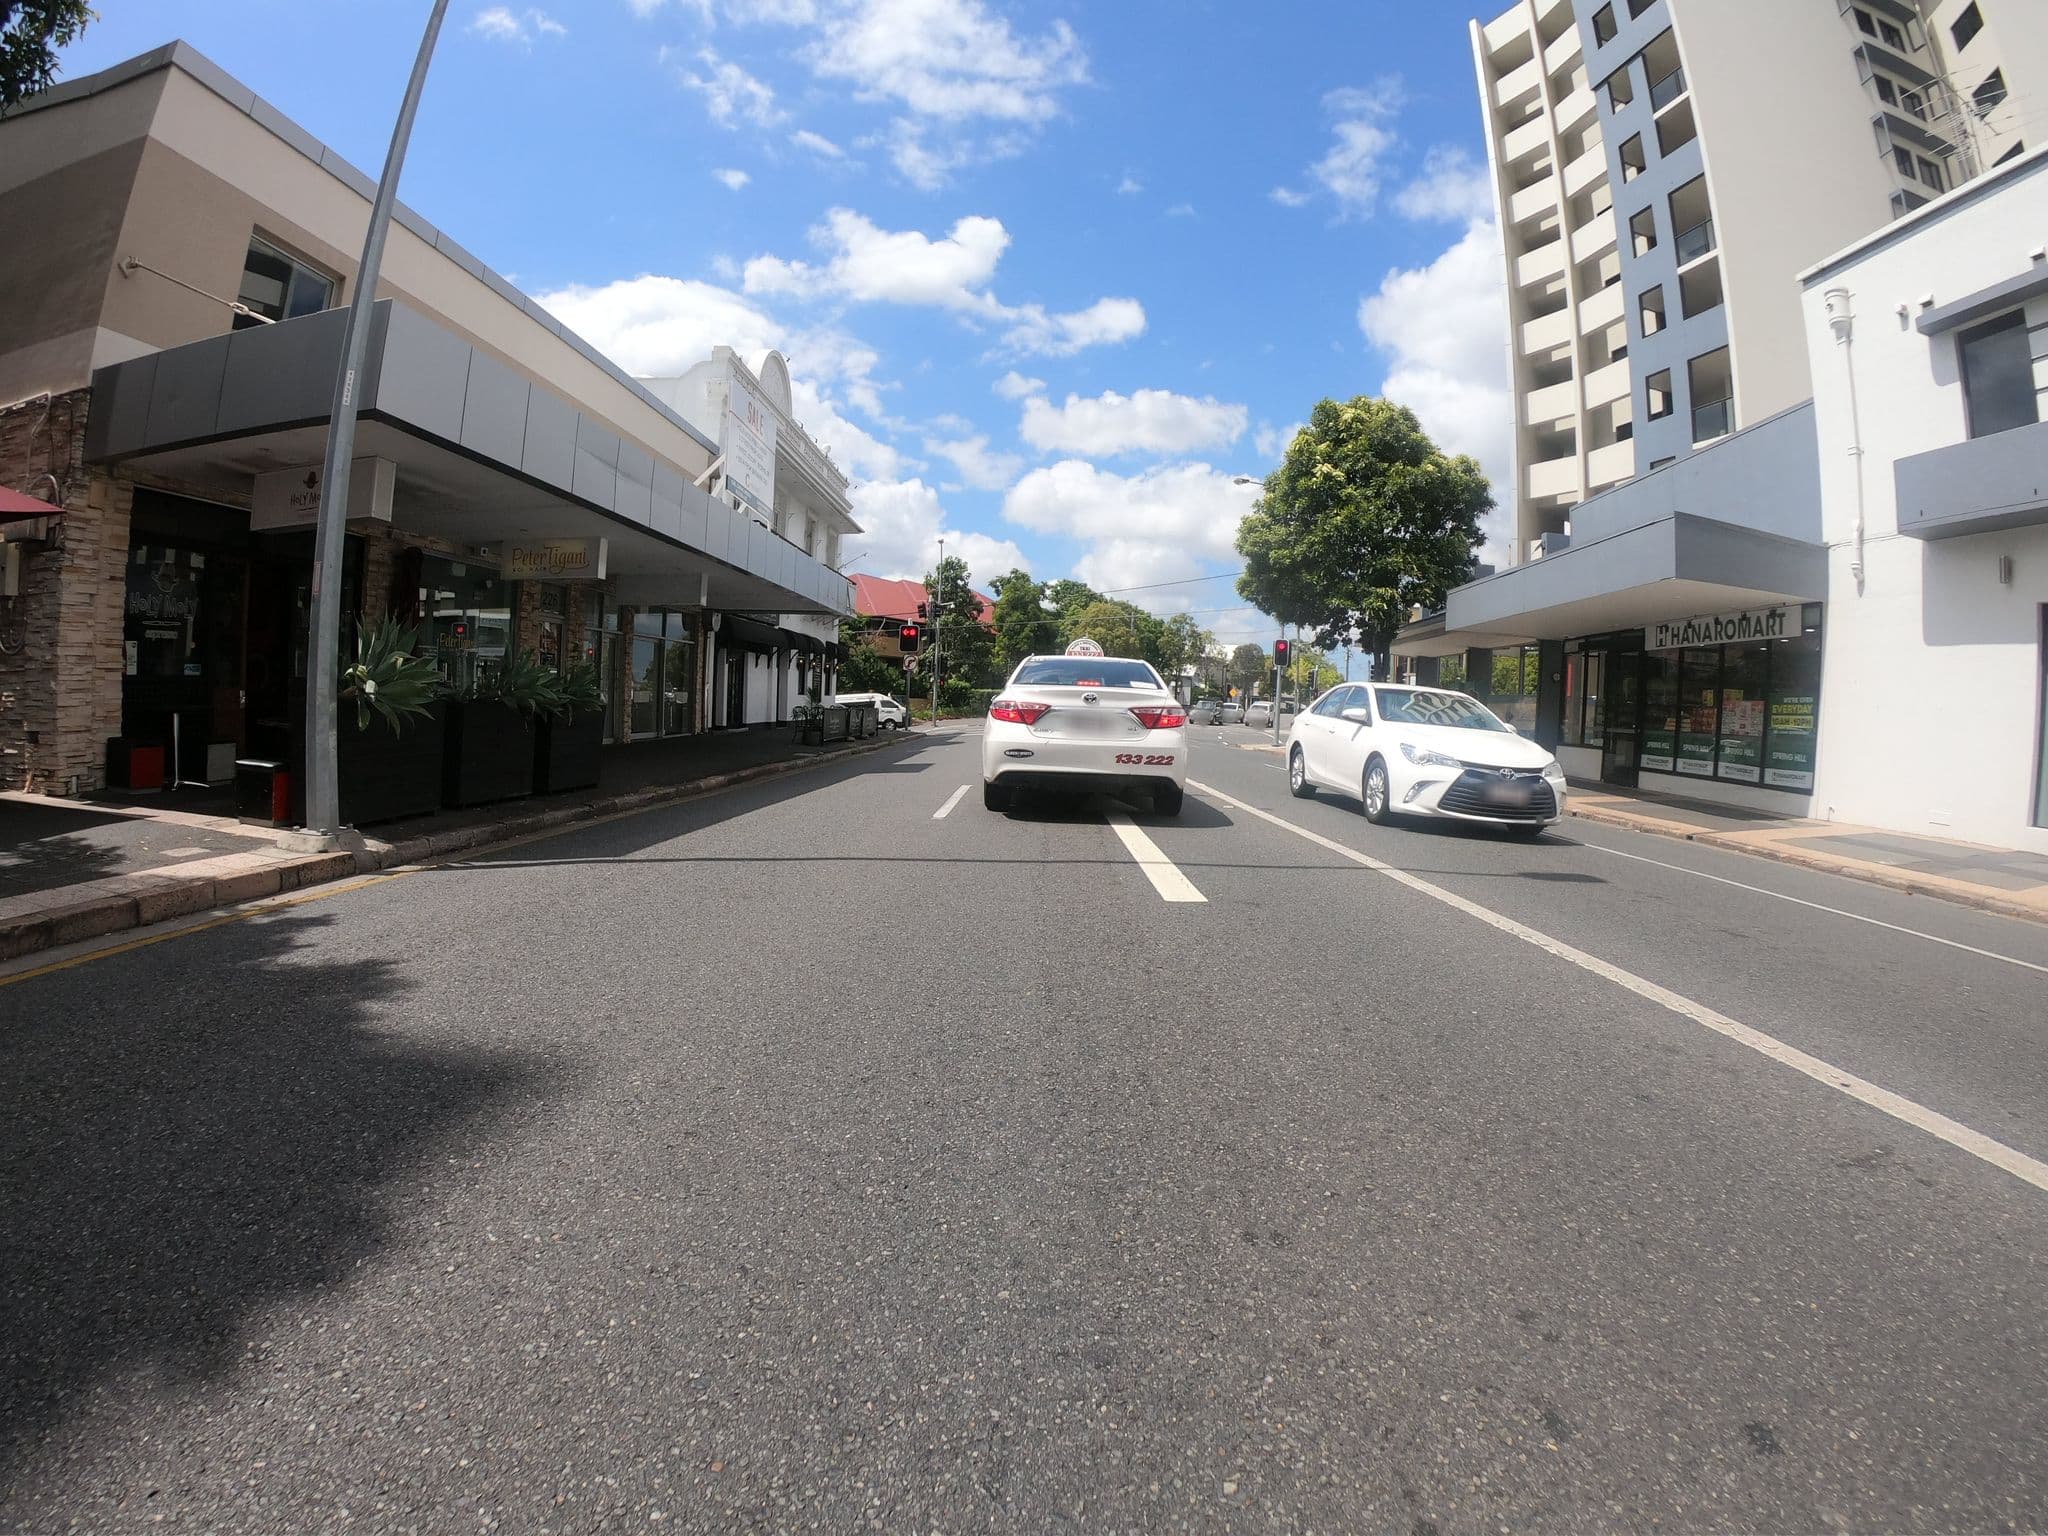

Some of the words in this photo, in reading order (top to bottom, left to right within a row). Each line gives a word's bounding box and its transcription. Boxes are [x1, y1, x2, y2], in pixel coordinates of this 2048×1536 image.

[747, 402, 764, 436] SALE
[512, 547, 546, 566] Peter
[544, 545, 590, 574] Tigani
[1670, 612, 1786, 646] HANAROMART
[1772, 704, 1813, 714] EVERYDAY
[1115, 753, 1143, 765] 133
[1143, 755, 1175, 766] 222
[1772, 752, 1793, 761] SPRING
[1794, 753, 1807, 763] HILL
